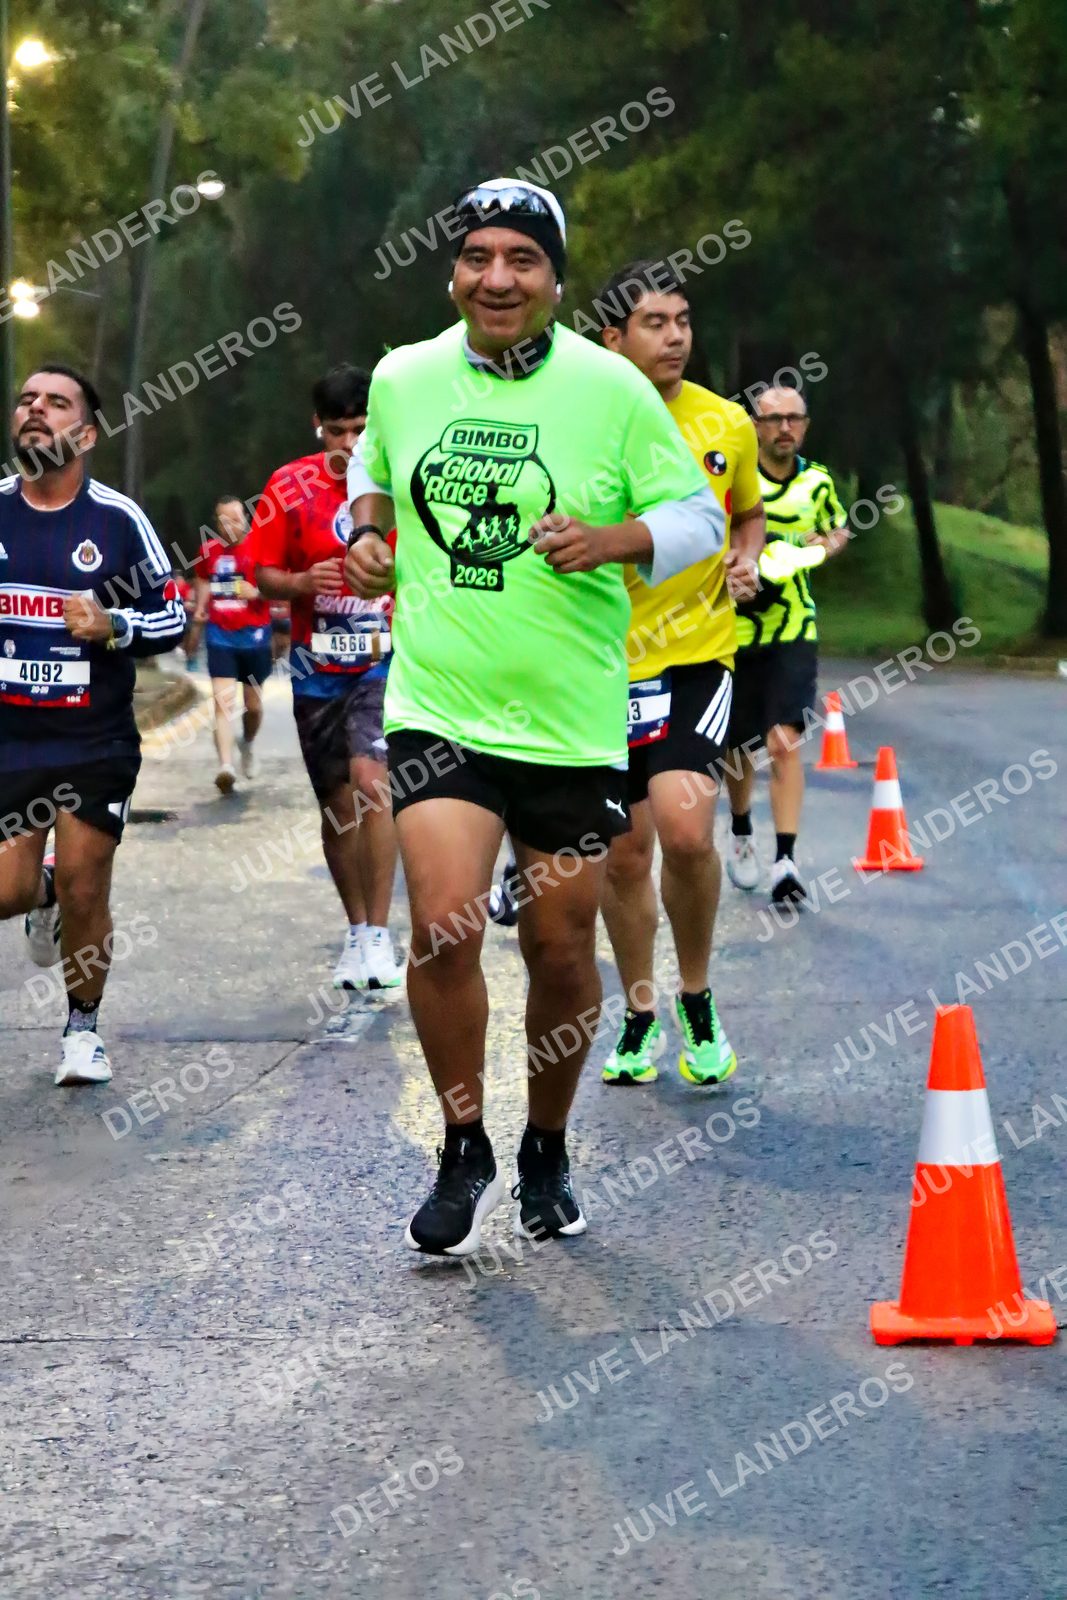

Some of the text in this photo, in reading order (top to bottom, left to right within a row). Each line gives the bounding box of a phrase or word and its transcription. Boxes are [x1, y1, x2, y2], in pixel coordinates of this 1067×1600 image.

[452, 430, 528, 449] BIMBO
[441, 455, 524, 486] Global
[424, 475, 489, 507] Race
[454, 565, 498, 586] 2026
[330, 635, 366, 652] 4568
[20, 662, 63, 682] 4092
[627, 700, 642, 721] 3
